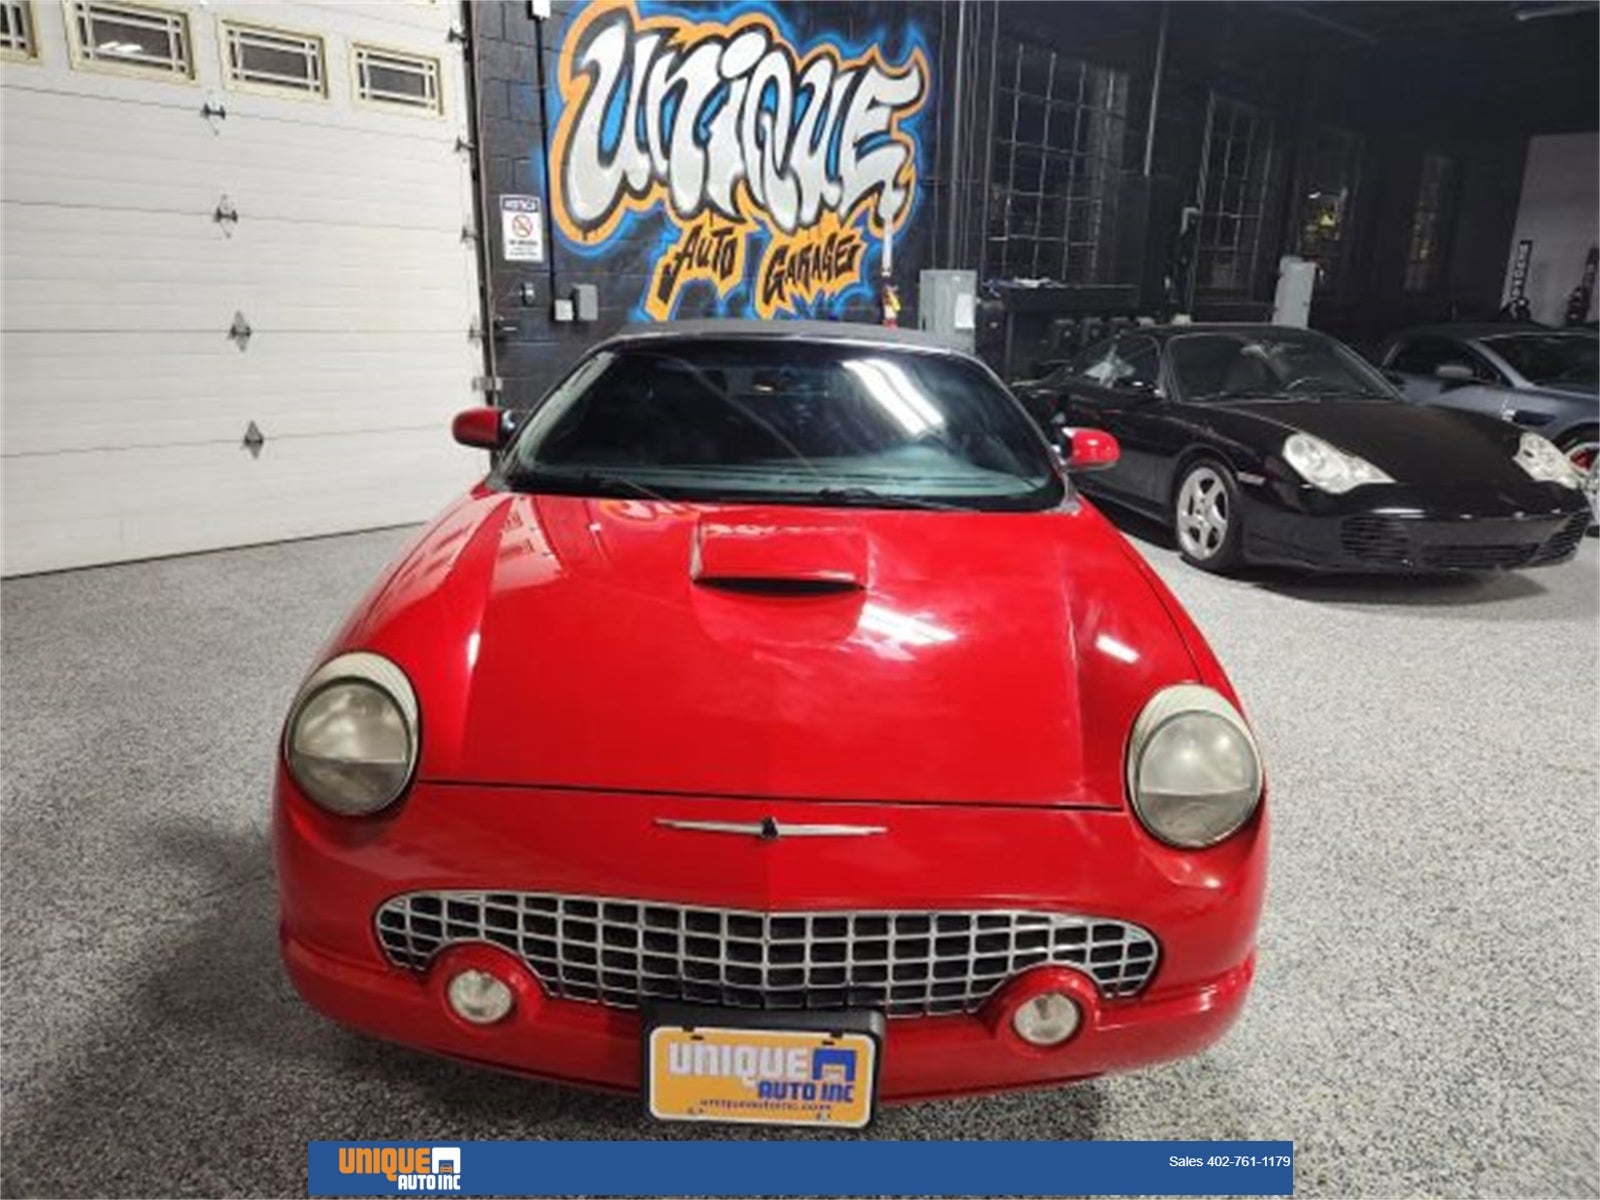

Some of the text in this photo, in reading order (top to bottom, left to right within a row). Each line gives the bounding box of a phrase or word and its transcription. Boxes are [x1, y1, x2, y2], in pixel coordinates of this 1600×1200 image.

[668, 1042, 808, 1087] UNIQUE
[758, 1080, 855, 1103] AUTO INC
